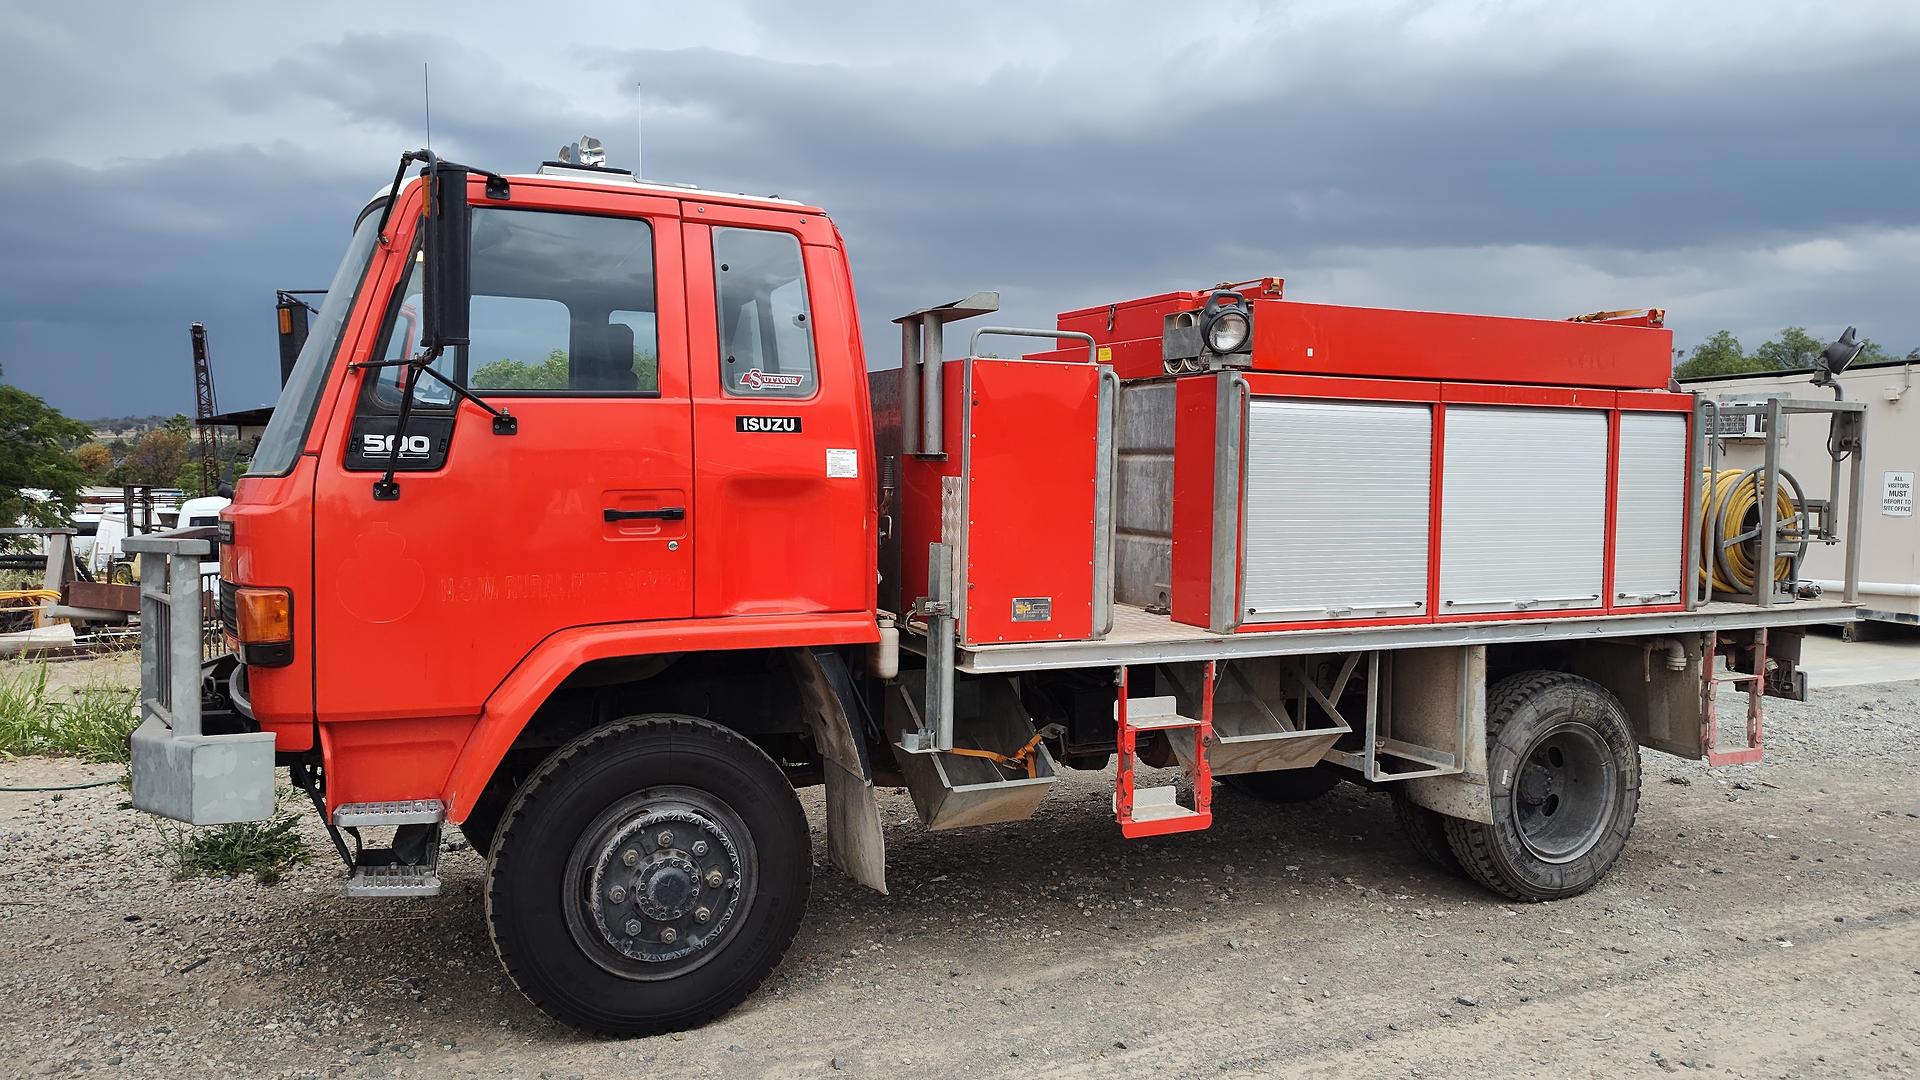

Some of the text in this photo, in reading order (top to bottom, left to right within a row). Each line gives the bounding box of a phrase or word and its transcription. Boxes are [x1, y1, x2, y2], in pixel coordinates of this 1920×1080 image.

[750, 371, 797, 387] SUTTONS
[743, 418, 795, 431] ISUZU
[363, 434, 430, 452] 500
